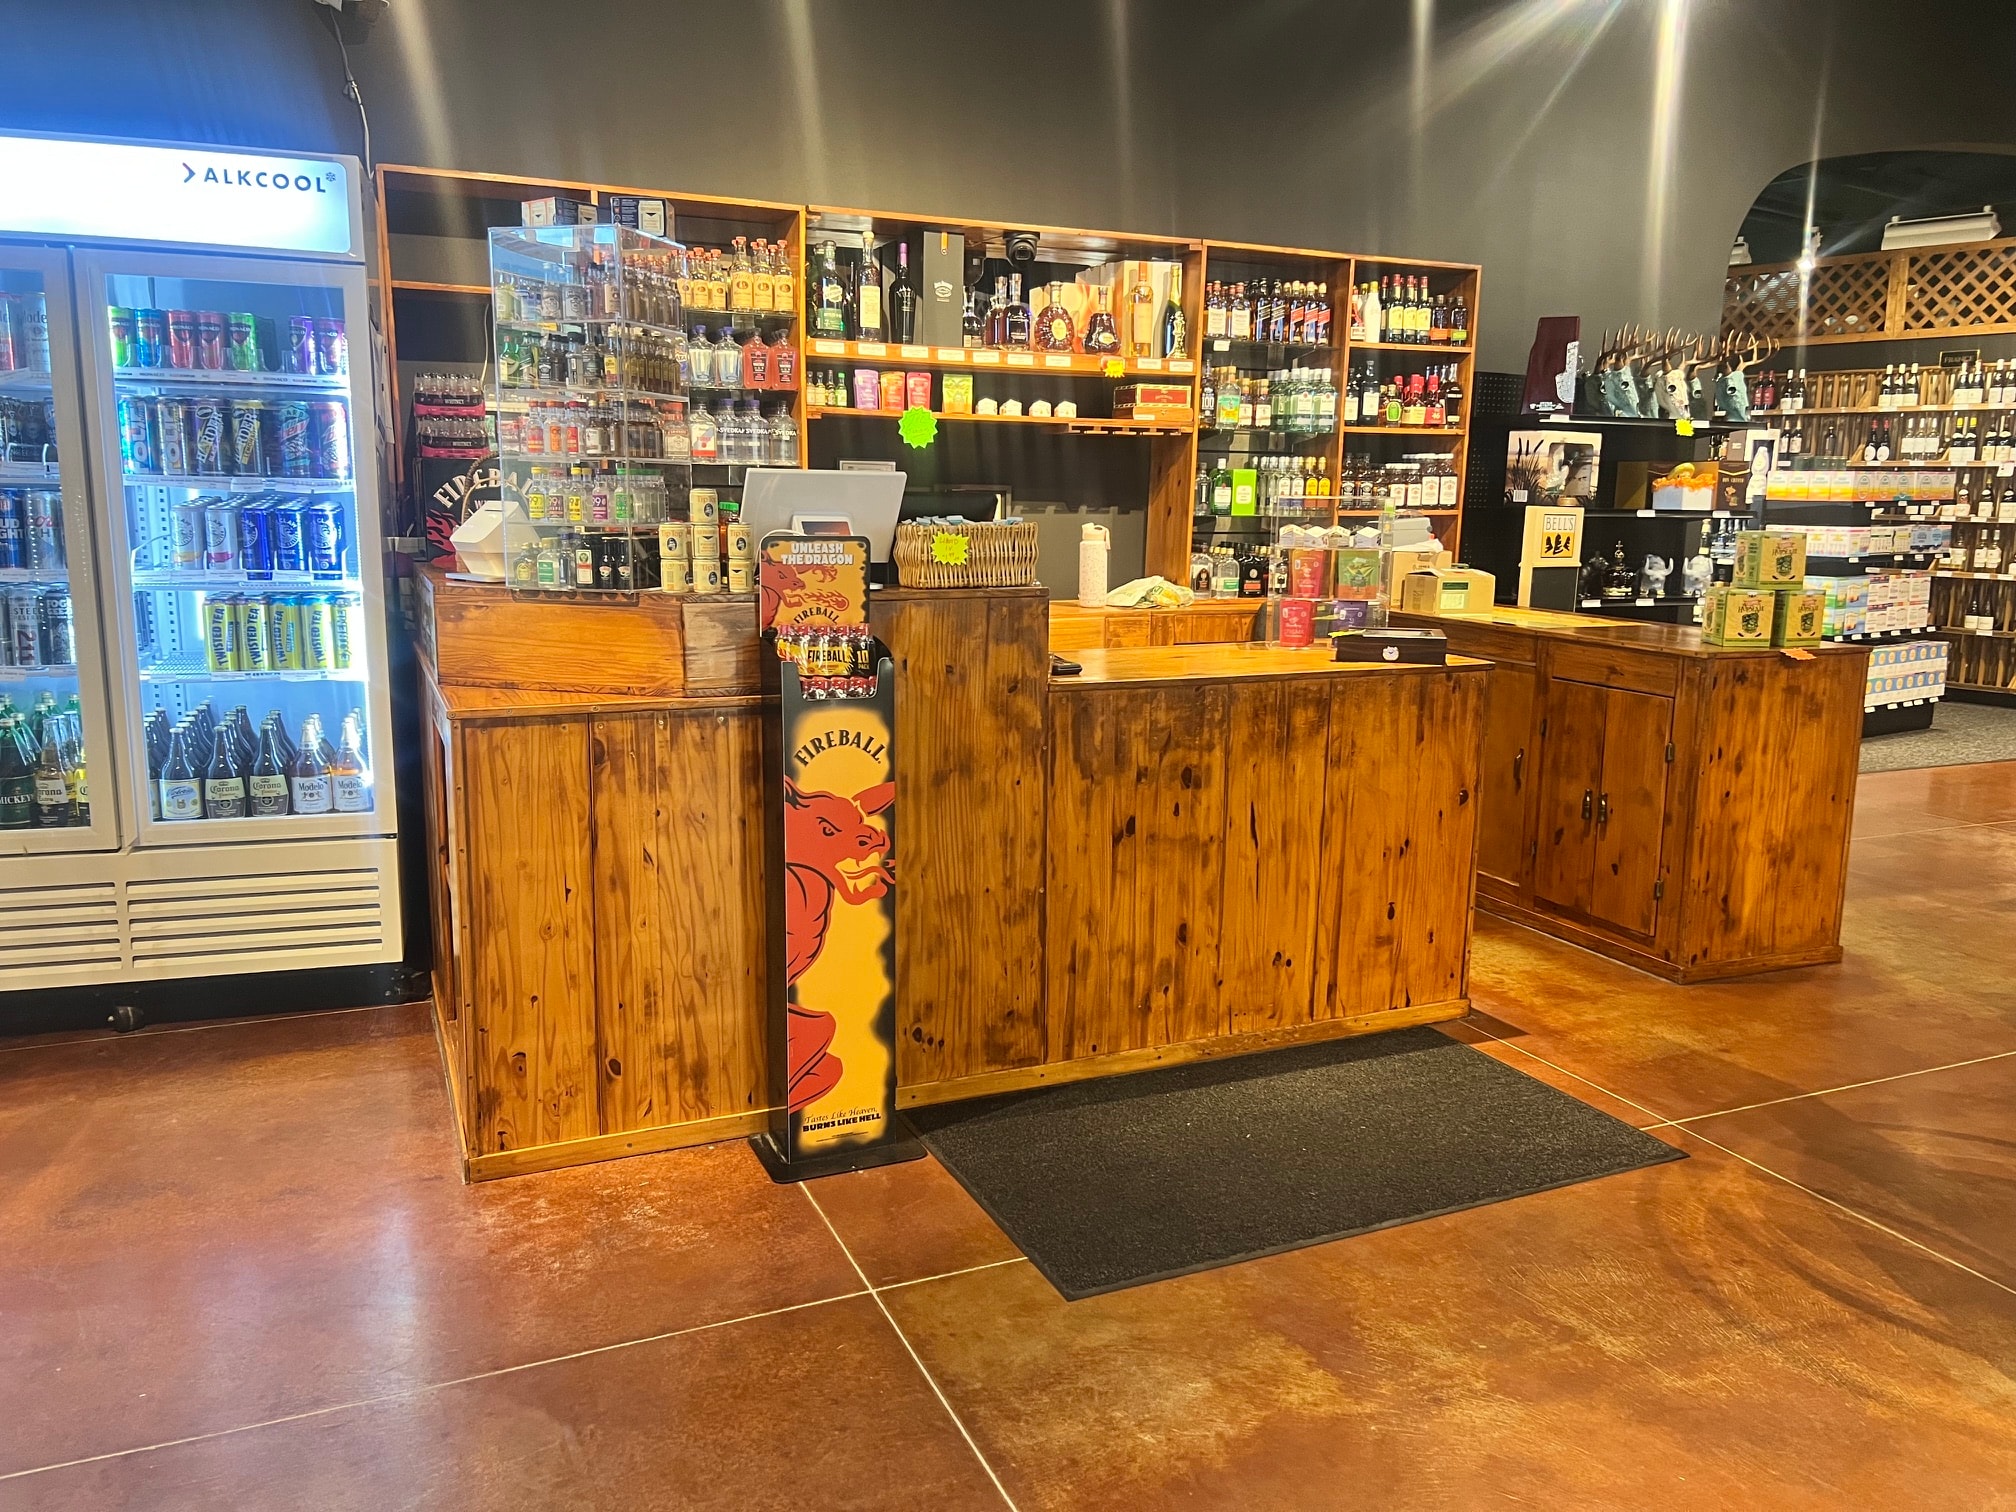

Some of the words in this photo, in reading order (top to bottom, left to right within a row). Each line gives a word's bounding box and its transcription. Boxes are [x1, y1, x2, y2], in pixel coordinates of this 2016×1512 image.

[204, 167, 326, 193] ALKCOOL
[1545, 517, 1574, 531] BELL'S
[791, 543, 845, 554] UNLEASH
[781, 554, 804, 565] THE
[805, 554, 854, 566] DRAGON
[213, 608, 226, 626] TEA
[247, 608, 260, 625] TEA
[273, 610, 285, 625] TEA
[311, 610, 323, 625] TEA
[793, 606, 841, 625] FIREBALL
[212, 626, 229, 667] TWISTED
[247, 625, 264, 666] TWISTED
[273, 625, 288, 664] TWISTED
[311, 625, 327, 664] TWISTED
[808, 649, 847, 662] FIREBALL
[857, 649, 869, 662] 10
[793, 729, 886, 767] FIREBALL
[209, 784, 240, 795] Corona
[252, 781, 282, 791] Corona
[298, 782, 325, 792] Modelo
[337, 780, 363, 790] Modelo
[802, 1120, 836, 1132] BURNS
[837, 1117, 858, 1127] LIKE
[858, 1112, 882, 1123] HELL
[804, 1115, 829, 1124] Tastes
[831, 1111, 847, 1120] Like
